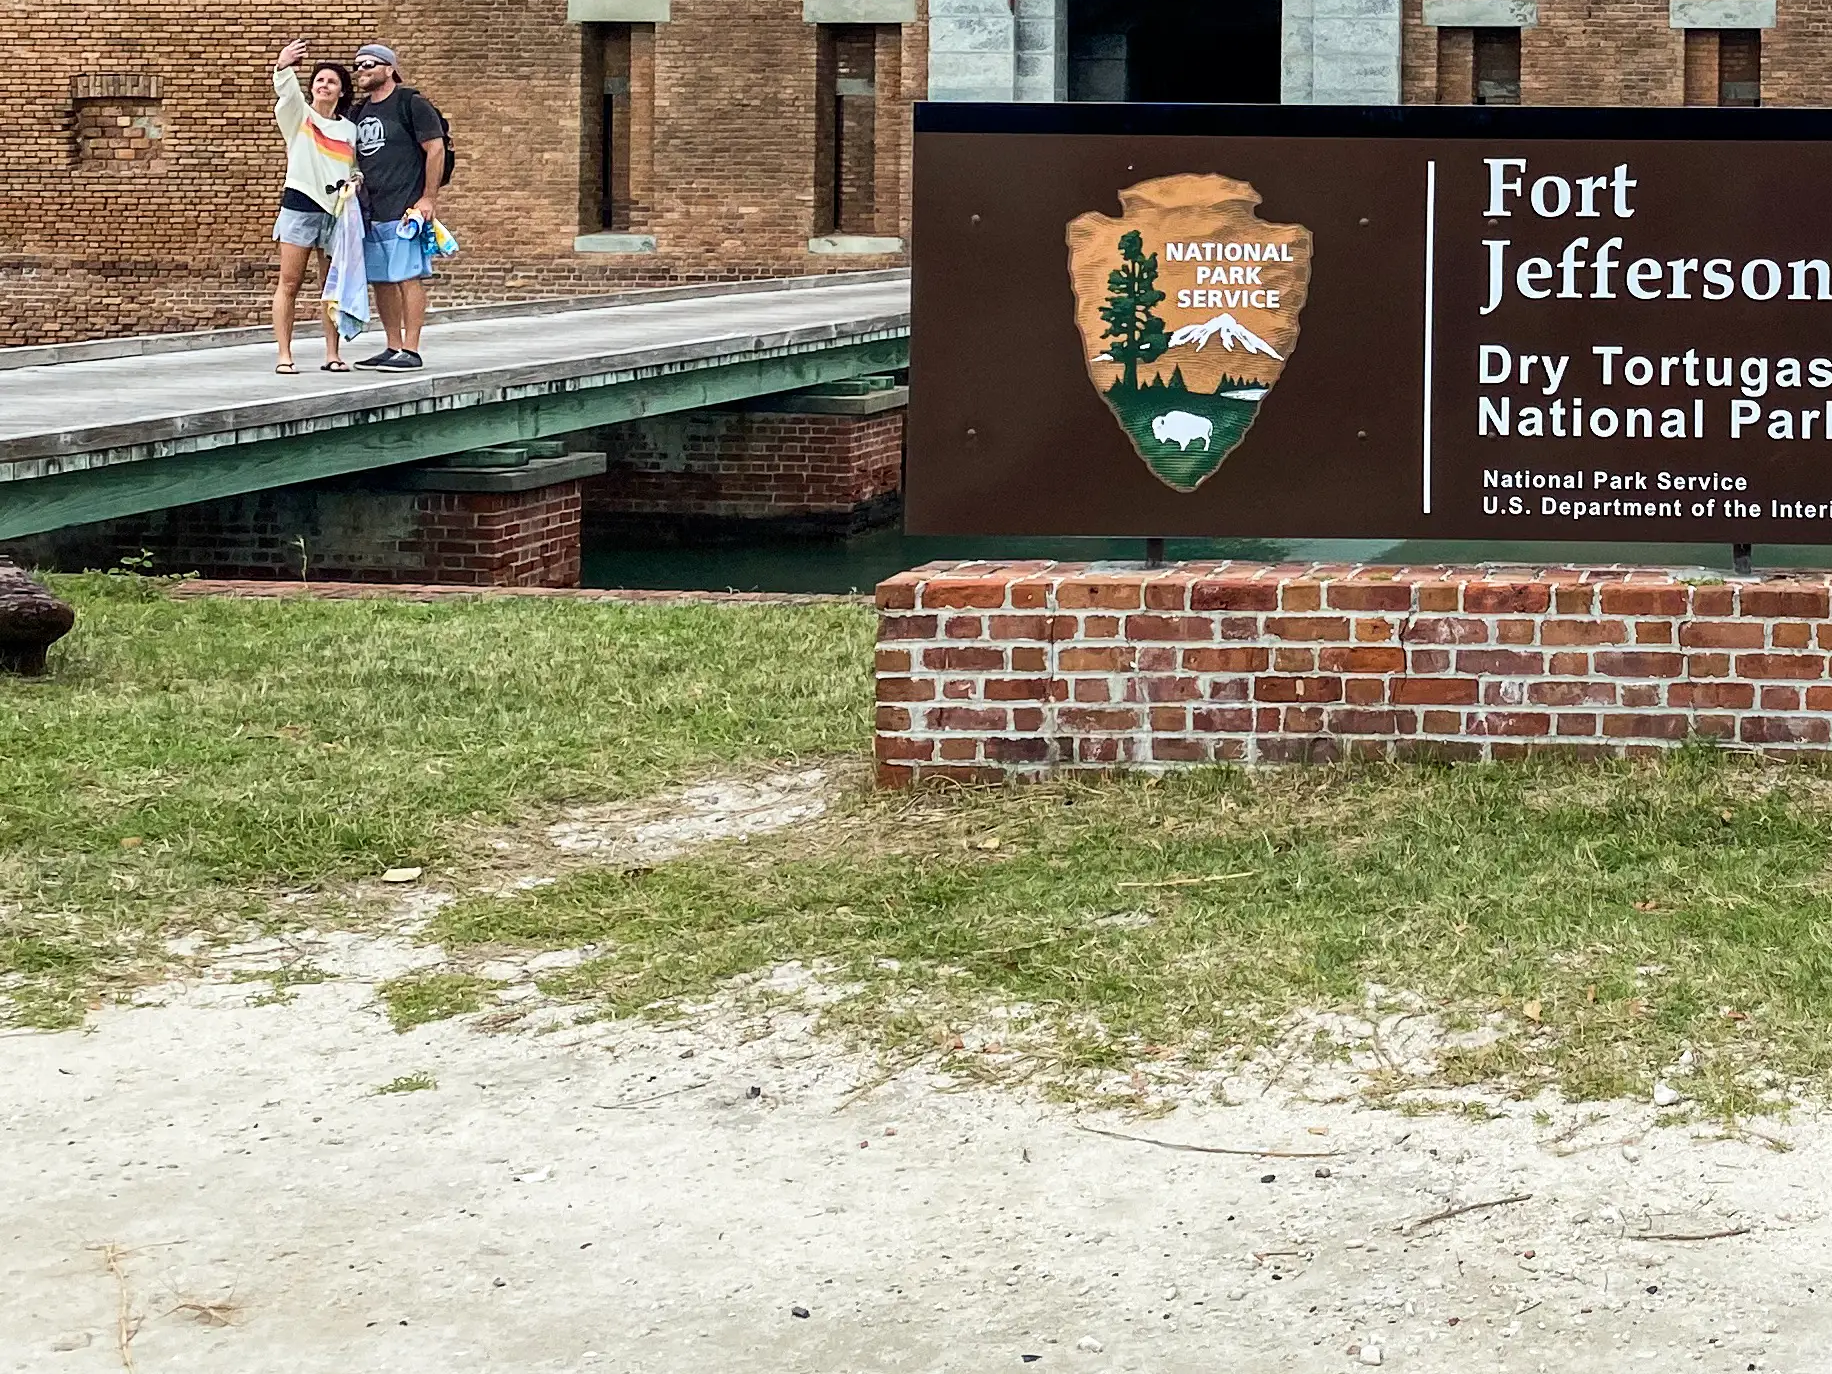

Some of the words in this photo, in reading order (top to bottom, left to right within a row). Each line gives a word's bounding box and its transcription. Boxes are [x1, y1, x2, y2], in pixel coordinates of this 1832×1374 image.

[1482, 158, 1638, 218] Fort
[1165, 242, 1294, 262] NATIONAL
[1196, 266, 1263, 285] PARK
[1177, 289, 1280, 309] SERVICE
[1479, 344, 1570, 395] Dry
[1478, 396, 1704, 439] National
[1483, 469, 1583, 489] National
[1593, 470, 1648, 490] Park
[1656, 471, 1748, 491] Service
[1483, 495, 1531, 515] U.S.
[1541, 496, 1682, 520] Department
[1691, 498, 1716, 517] of
[1723, 499, 1762, 518] the
